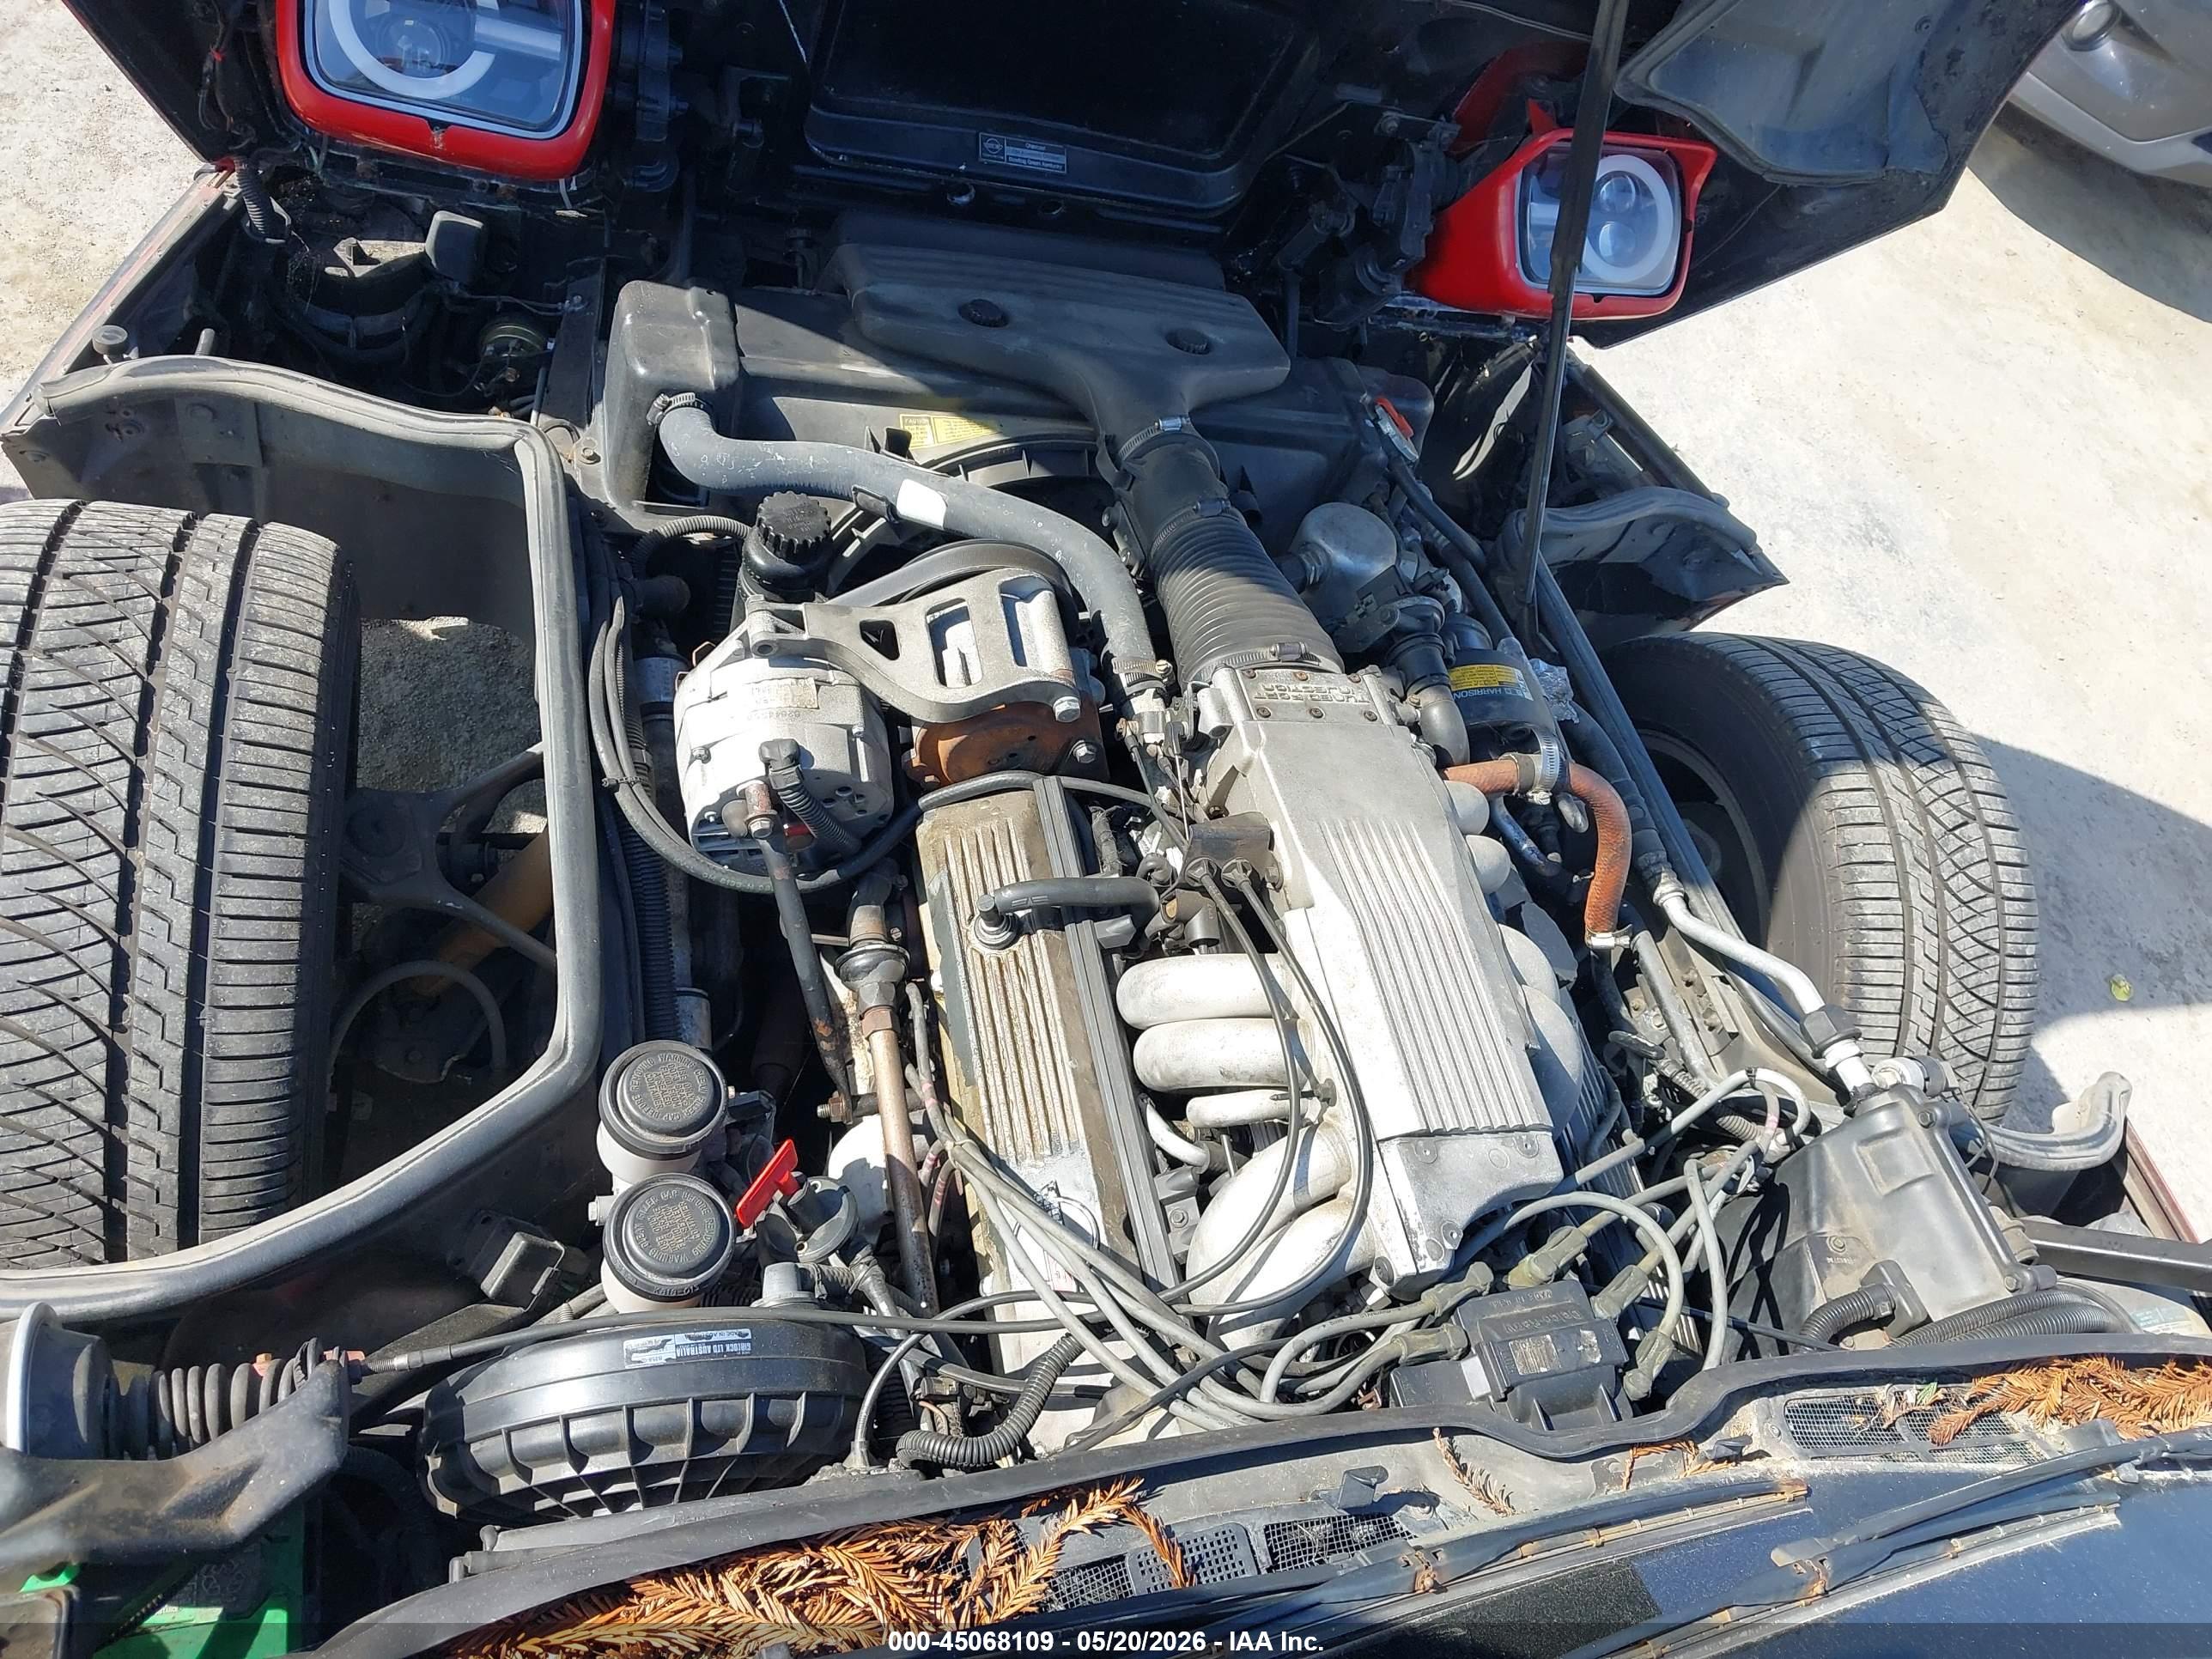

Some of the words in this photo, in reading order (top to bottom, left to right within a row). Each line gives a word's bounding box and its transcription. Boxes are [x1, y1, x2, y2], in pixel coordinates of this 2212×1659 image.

[1452, 688, 1502, 699] HARRISON
[658, 1053, 696, 1069] WARNING
[629, 1058, 654, 1091] REMOVING
[693, 1071, 708, 1094] CLEAN
[644, 1072, 665, 1109] CONTAINER
[632, 1093, 660, 1120] BEFORE
[664, 1111, 682, 1121] CAP
[685, 1096, 706, 1117] FILLER
[681, 1191, 711, 1216] BEFORE
[647, 1214, 662, 1233] ONLY
[671, 1205, 690, 1235] SEALED
[680, 1200, 702, 1242] CONTAINER
[656, 1235, 669, 1252] USE
[691, 1218, 715, 1255] REMOVING
[648, 1249, 690, 1264] WARNING
[676, 1345, 711, 1358] AUSTRALIA
[714, 1343, 724, 1354] LTD
[726, 1342, 751, 1352] GIRLOCK
